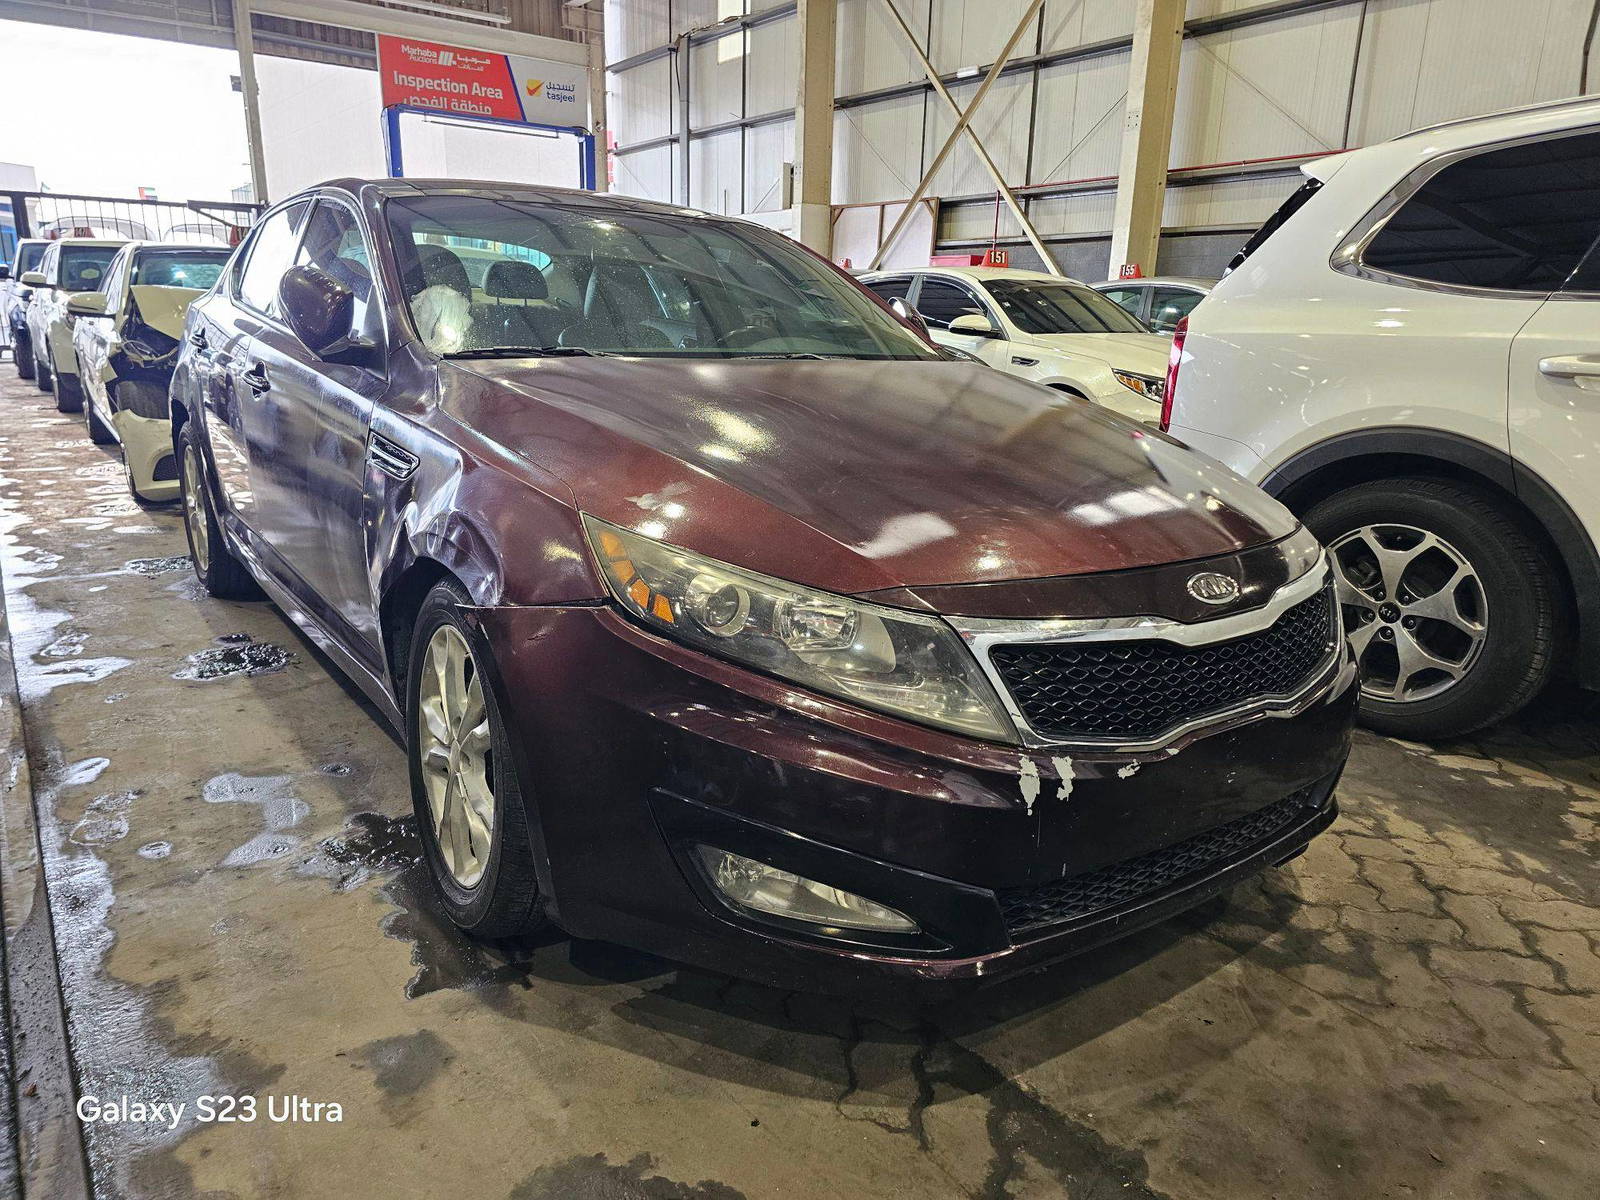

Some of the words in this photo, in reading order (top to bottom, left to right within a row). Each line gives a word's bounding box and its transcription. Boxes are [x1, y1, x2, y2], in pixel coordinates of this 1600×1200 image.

[401, 44, 437, 58] Marhaba
[409, 55, 438, 65] Auctions
[393, 70, 468, 94] Inspection
[471, 82, 503, 99] Area
[546, 81, 576, 92] تسجيل
[546, 91, 576, 103] tasjeel
[450, 98, 492, 115] منطقة
[990, 251, 1006, 264] 151
[1121, 264, 1135, 277] 155
[1194, 577, 1233, 598] KIA
